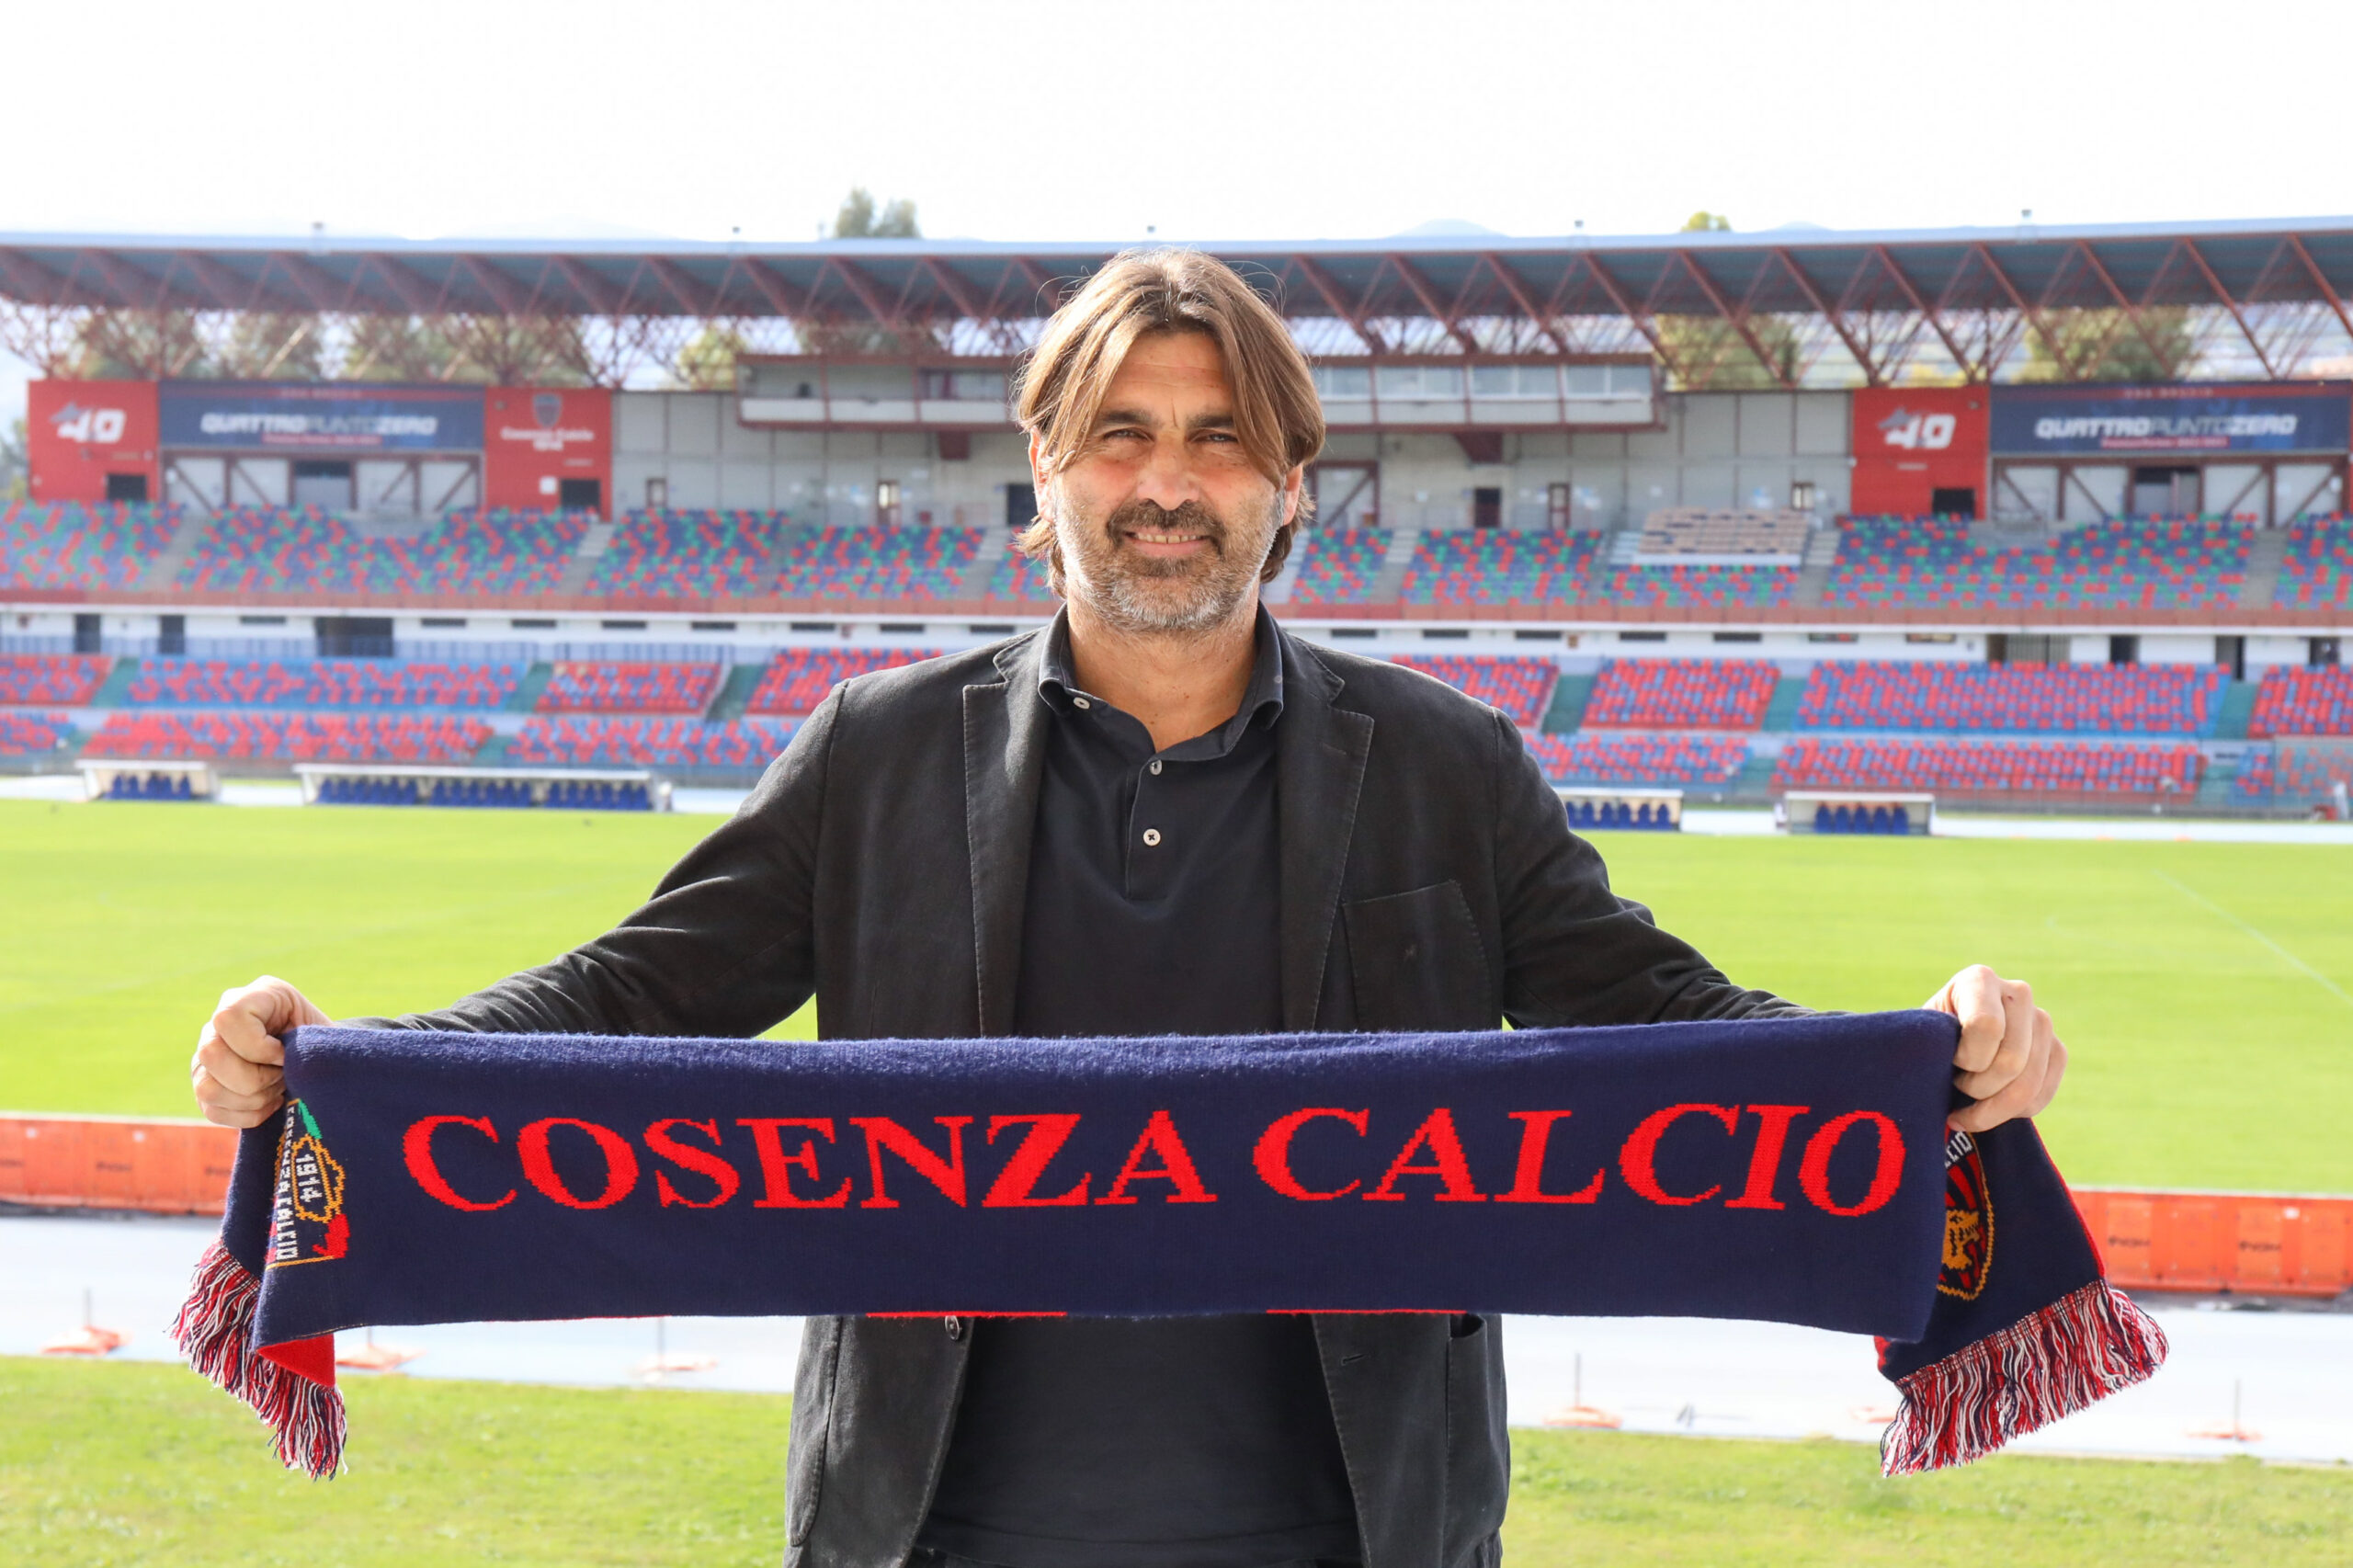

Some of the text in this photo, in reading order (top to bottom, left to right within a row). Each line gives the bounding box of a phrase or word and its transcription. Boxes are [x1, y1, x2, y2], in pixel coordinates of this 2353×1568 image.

[295, 1153, 323, 1203] 1914
[404, 1104, 1906, 1217] COSENZA CALCIO
